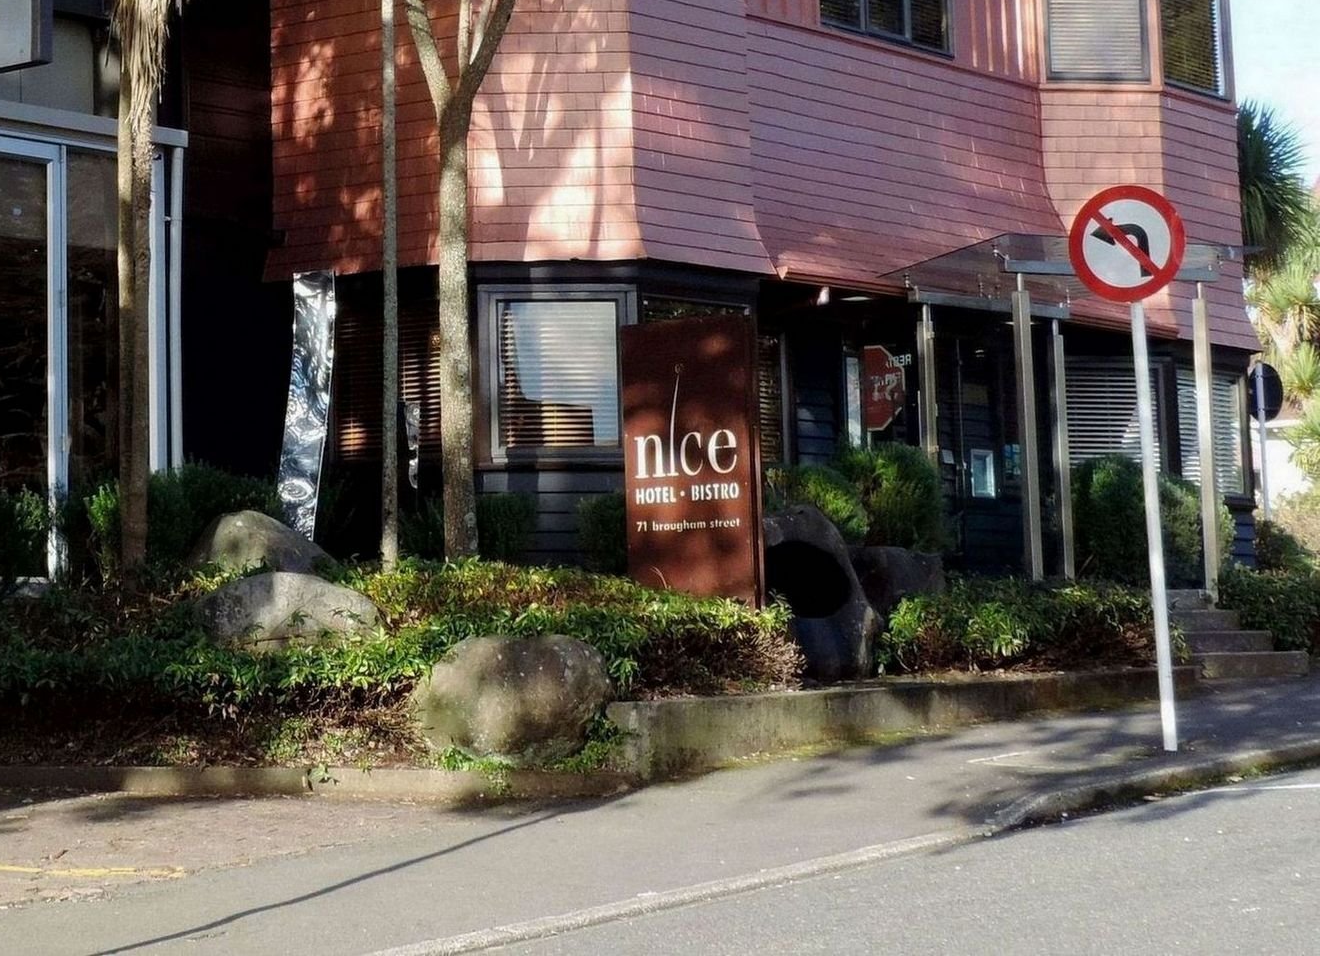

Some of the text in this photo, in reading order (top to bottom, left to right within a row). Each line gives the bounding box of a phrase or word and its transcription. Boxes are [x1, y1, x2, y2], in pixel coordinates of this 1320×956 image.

[635, 482, 740, 505] HOTEL BISTRO
[636, 518, 741, 533] 71 brougham street
